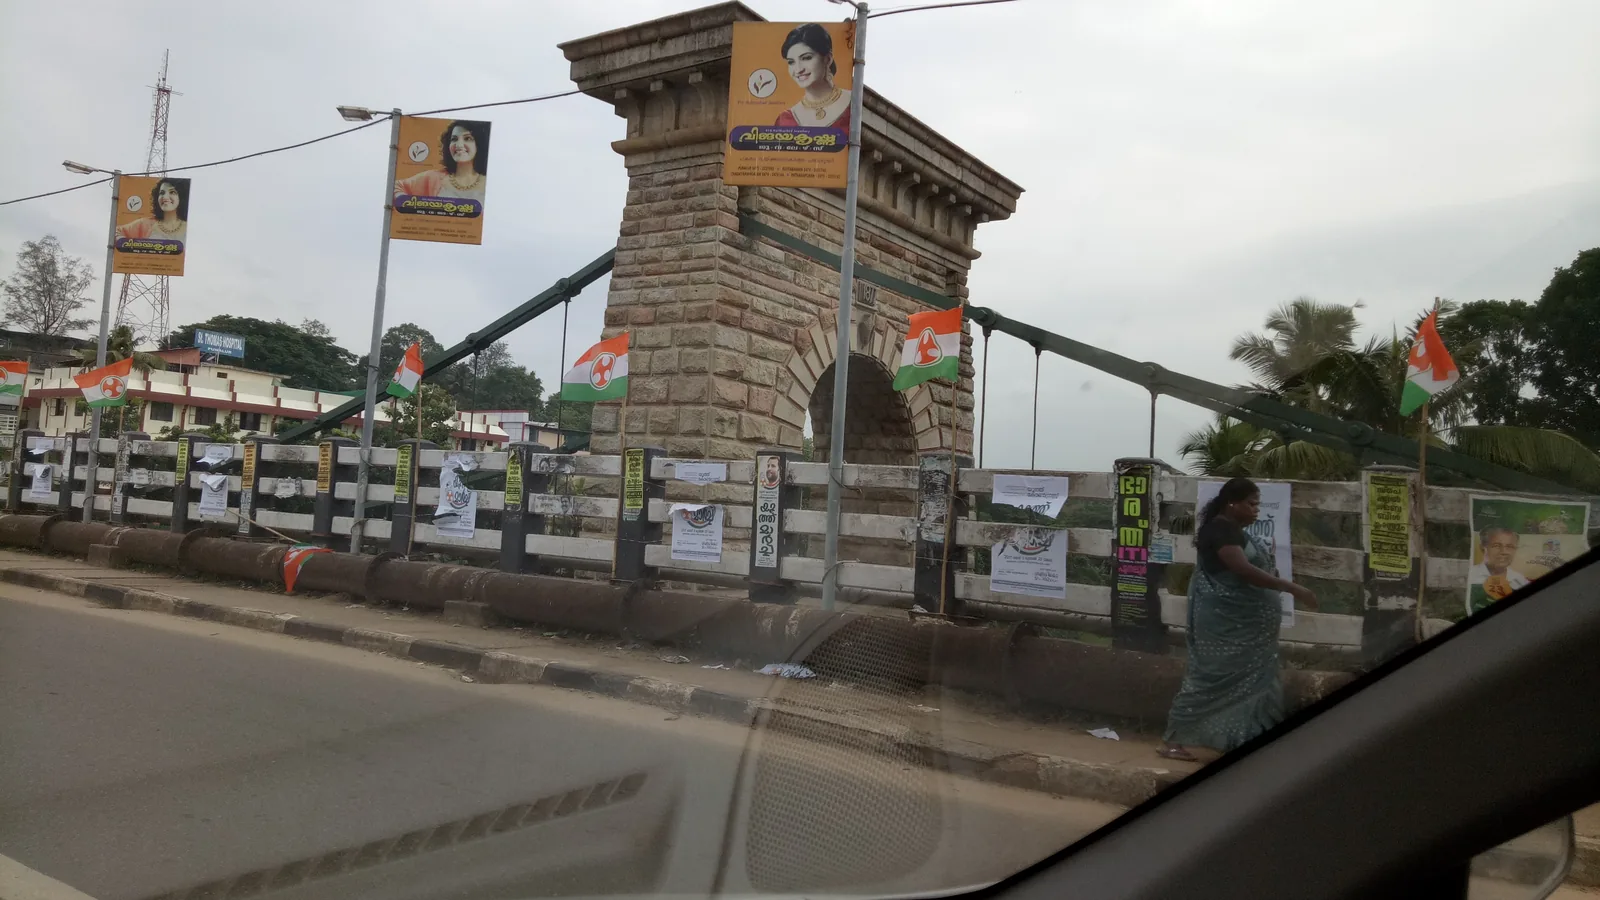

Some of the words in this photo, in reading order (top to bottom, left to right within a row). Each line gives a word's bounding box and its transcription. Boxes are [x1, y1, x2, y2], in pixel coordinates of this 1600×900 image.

[204, 333, 222, 347] THOMAS
[222, 336, 243, 351] HOSPITAL
[1117, 547, 1147, 561] ITI
